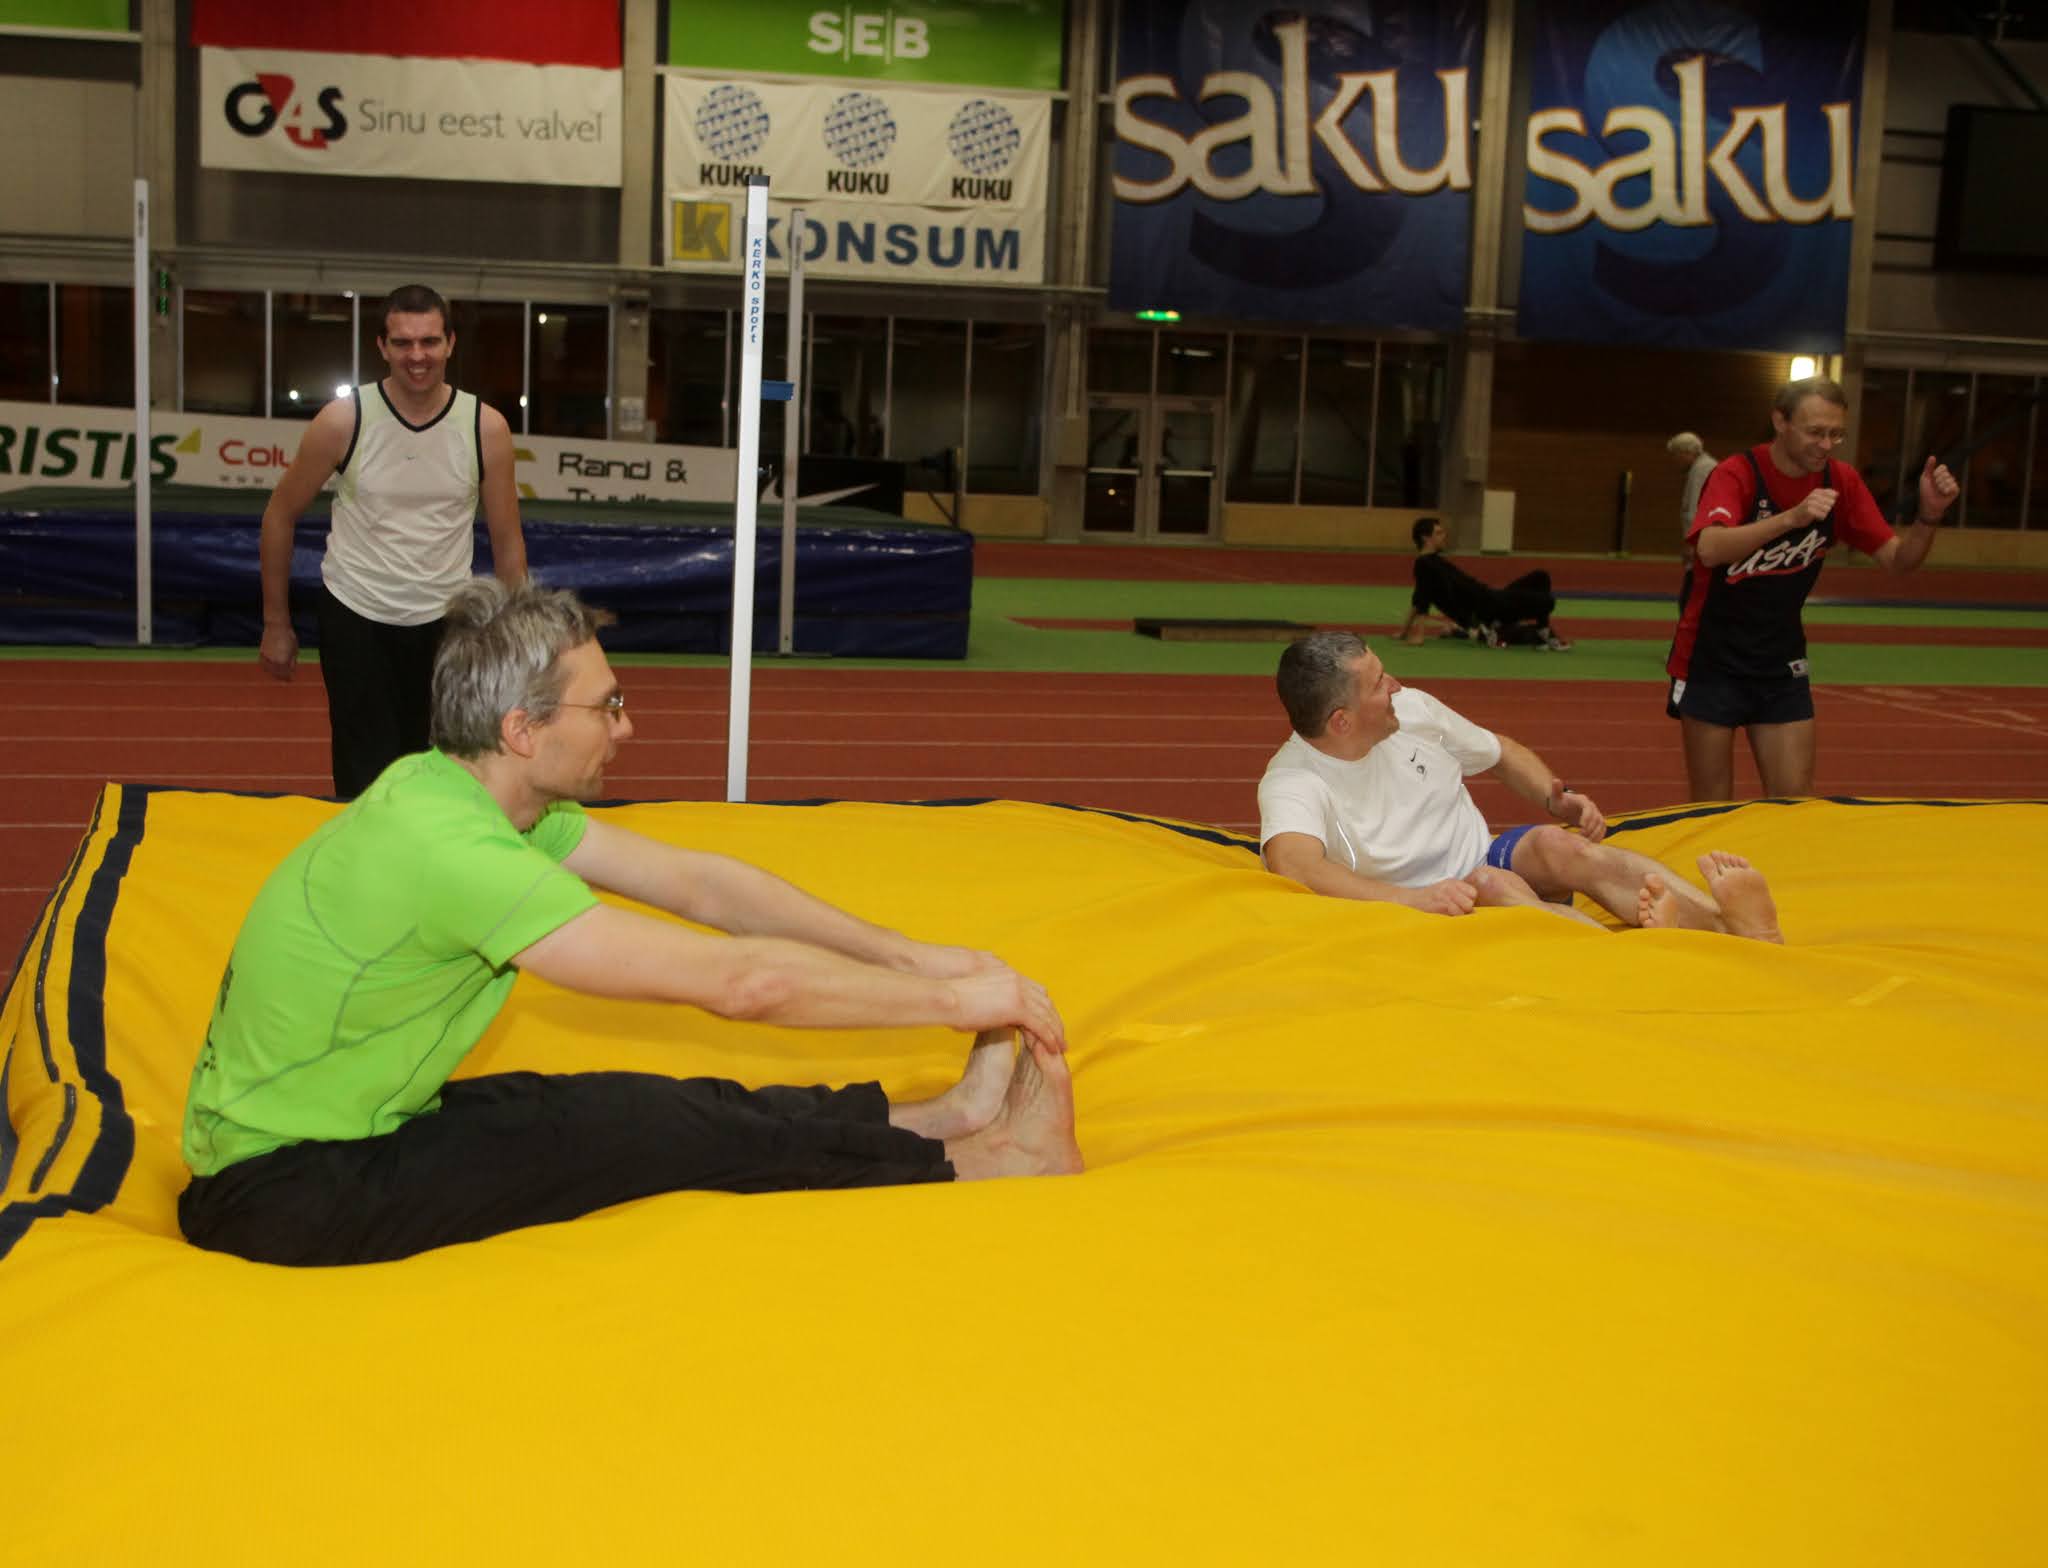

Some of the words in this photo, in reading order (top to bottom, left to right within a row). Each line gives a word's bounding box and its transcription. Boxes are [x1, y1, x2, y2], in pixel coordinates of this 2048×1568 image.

[224, 72, 347, 150] G4S
[359, 99, 425, 134] Sinu
[439, 111, 505, 139] eest
[516, 108, 603, 145] valvel
[1112, 16, 1473, 200] saku
[1523, 53, 1855, 234] saku
[827, 170, 889, 195] KUKU
[951, 176, 1012, 201] KUKU
[751, 237, 762, 290] KERKO
[750, 296, 760, 343] sport
[558, 451, 651, 480] Rand
[665, 459, 688, 483] &
[1727, 528, 1827, 576] USA
